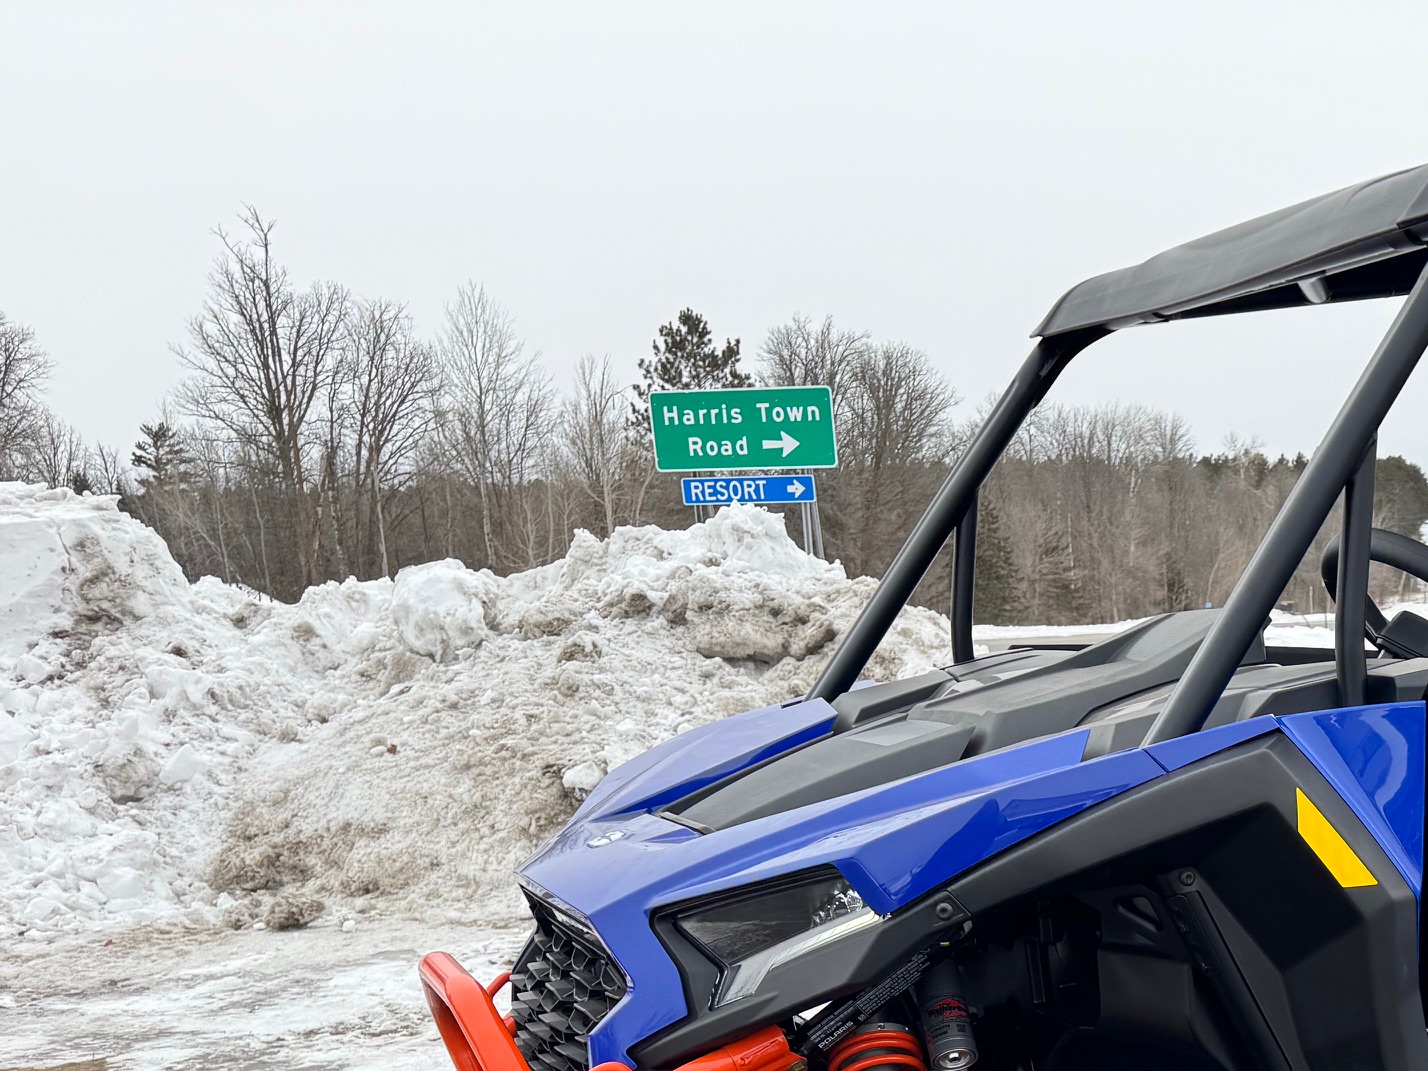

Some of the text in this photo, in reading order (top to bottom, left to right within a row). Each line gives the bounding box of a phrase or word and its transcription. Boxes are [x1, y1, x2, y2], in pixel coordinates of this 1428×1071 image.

[663, 402, 820, 425] Harris Town
[688, 436, 748, 456] Road
[690, 480, 767, 501] RESORT
[818, 1021, 854, 1049] POLARIS
